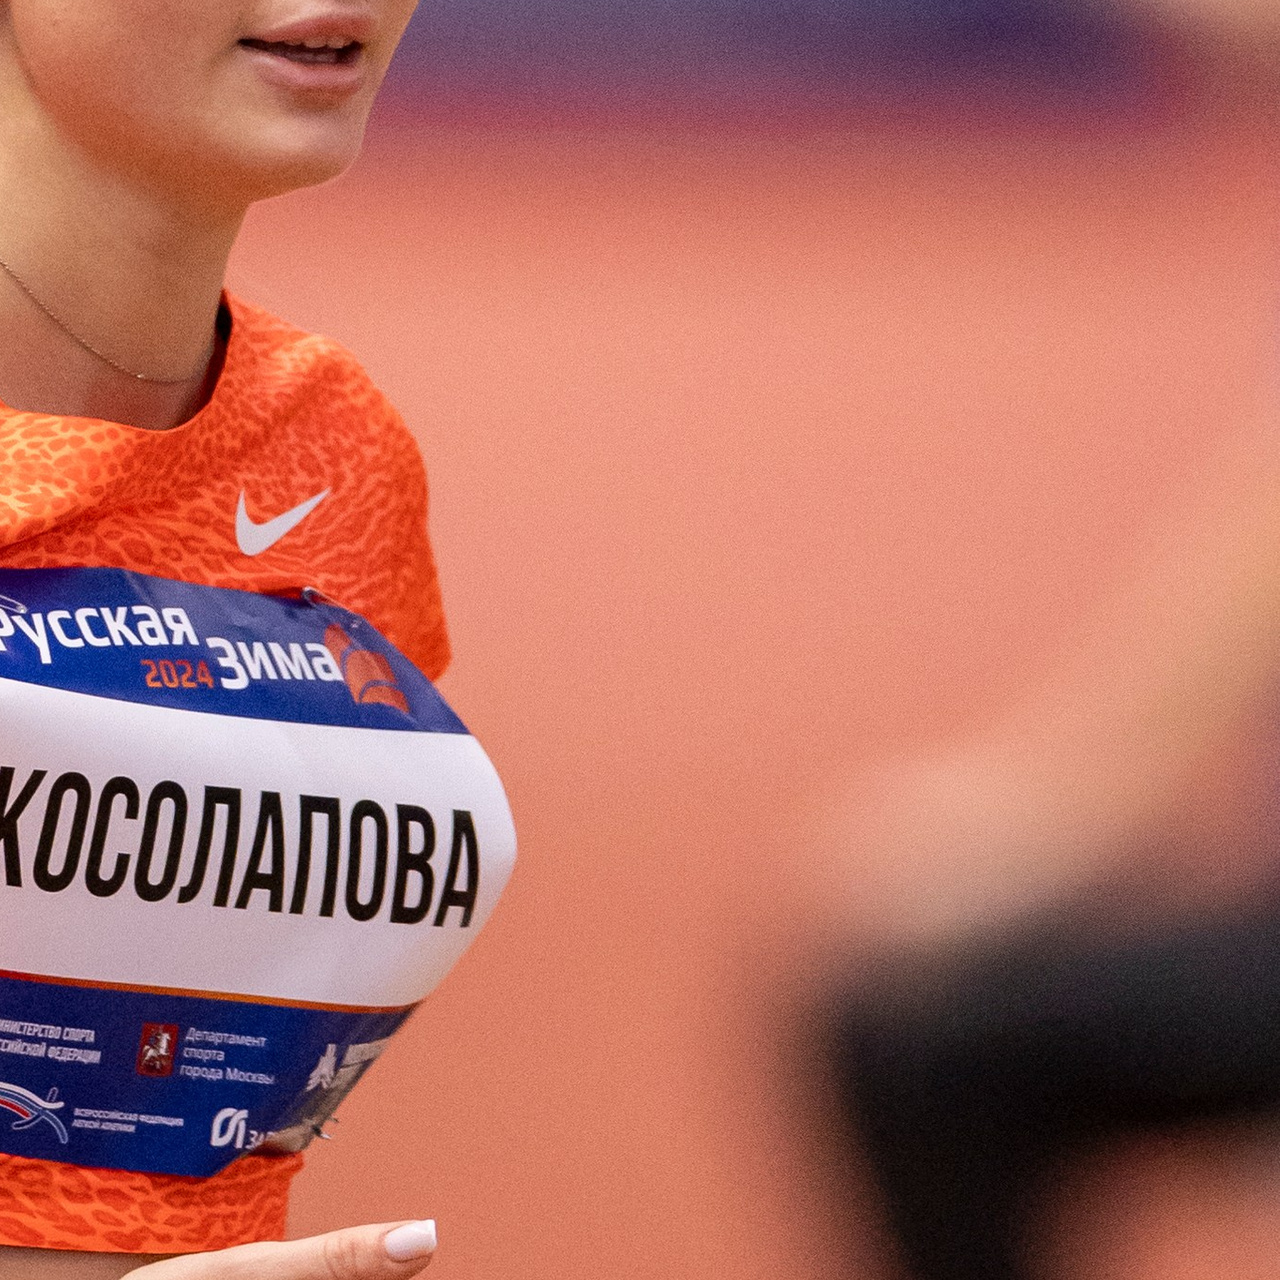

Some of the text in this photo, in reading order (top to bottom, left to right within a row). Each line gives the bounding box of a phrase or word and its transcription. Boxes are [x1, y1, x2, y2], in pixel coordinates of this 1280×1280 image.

[140, 636, 345, 690] 2024 Зима
[185, 1027, 267, 1047] Департамент
[183, 1047, 225, 1062] спорта
[180, 1065, 223, 1081] города
